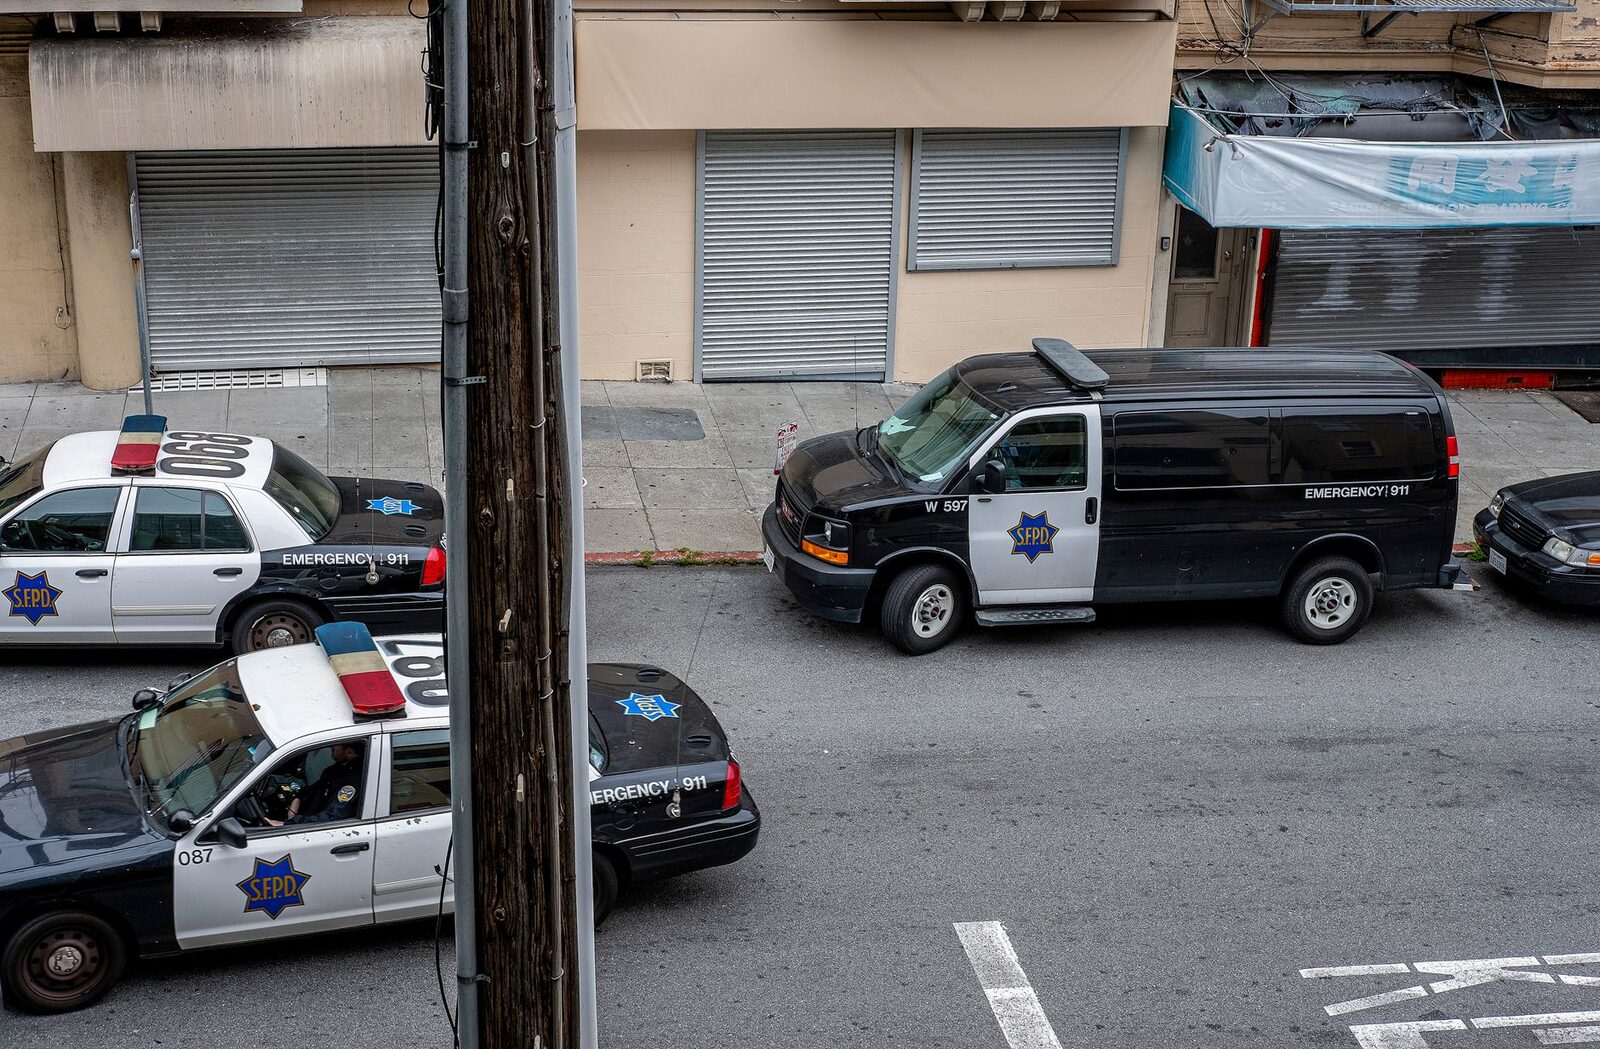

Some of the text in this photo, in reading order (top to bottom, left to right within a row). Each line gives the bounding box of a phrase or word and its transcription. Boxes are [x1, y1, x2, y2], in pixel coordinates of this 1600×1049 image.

[157, 431, 254, 478] 068
[1305, 485, 1409, 499] EMERGENCY 911
[925, 500, 968, 513] W 597
[282, 553, 409, 565] EMERGENCY 911
[590, 775, 707, 805] ERGENCY 911
[178, 848, 213, 867] 087
